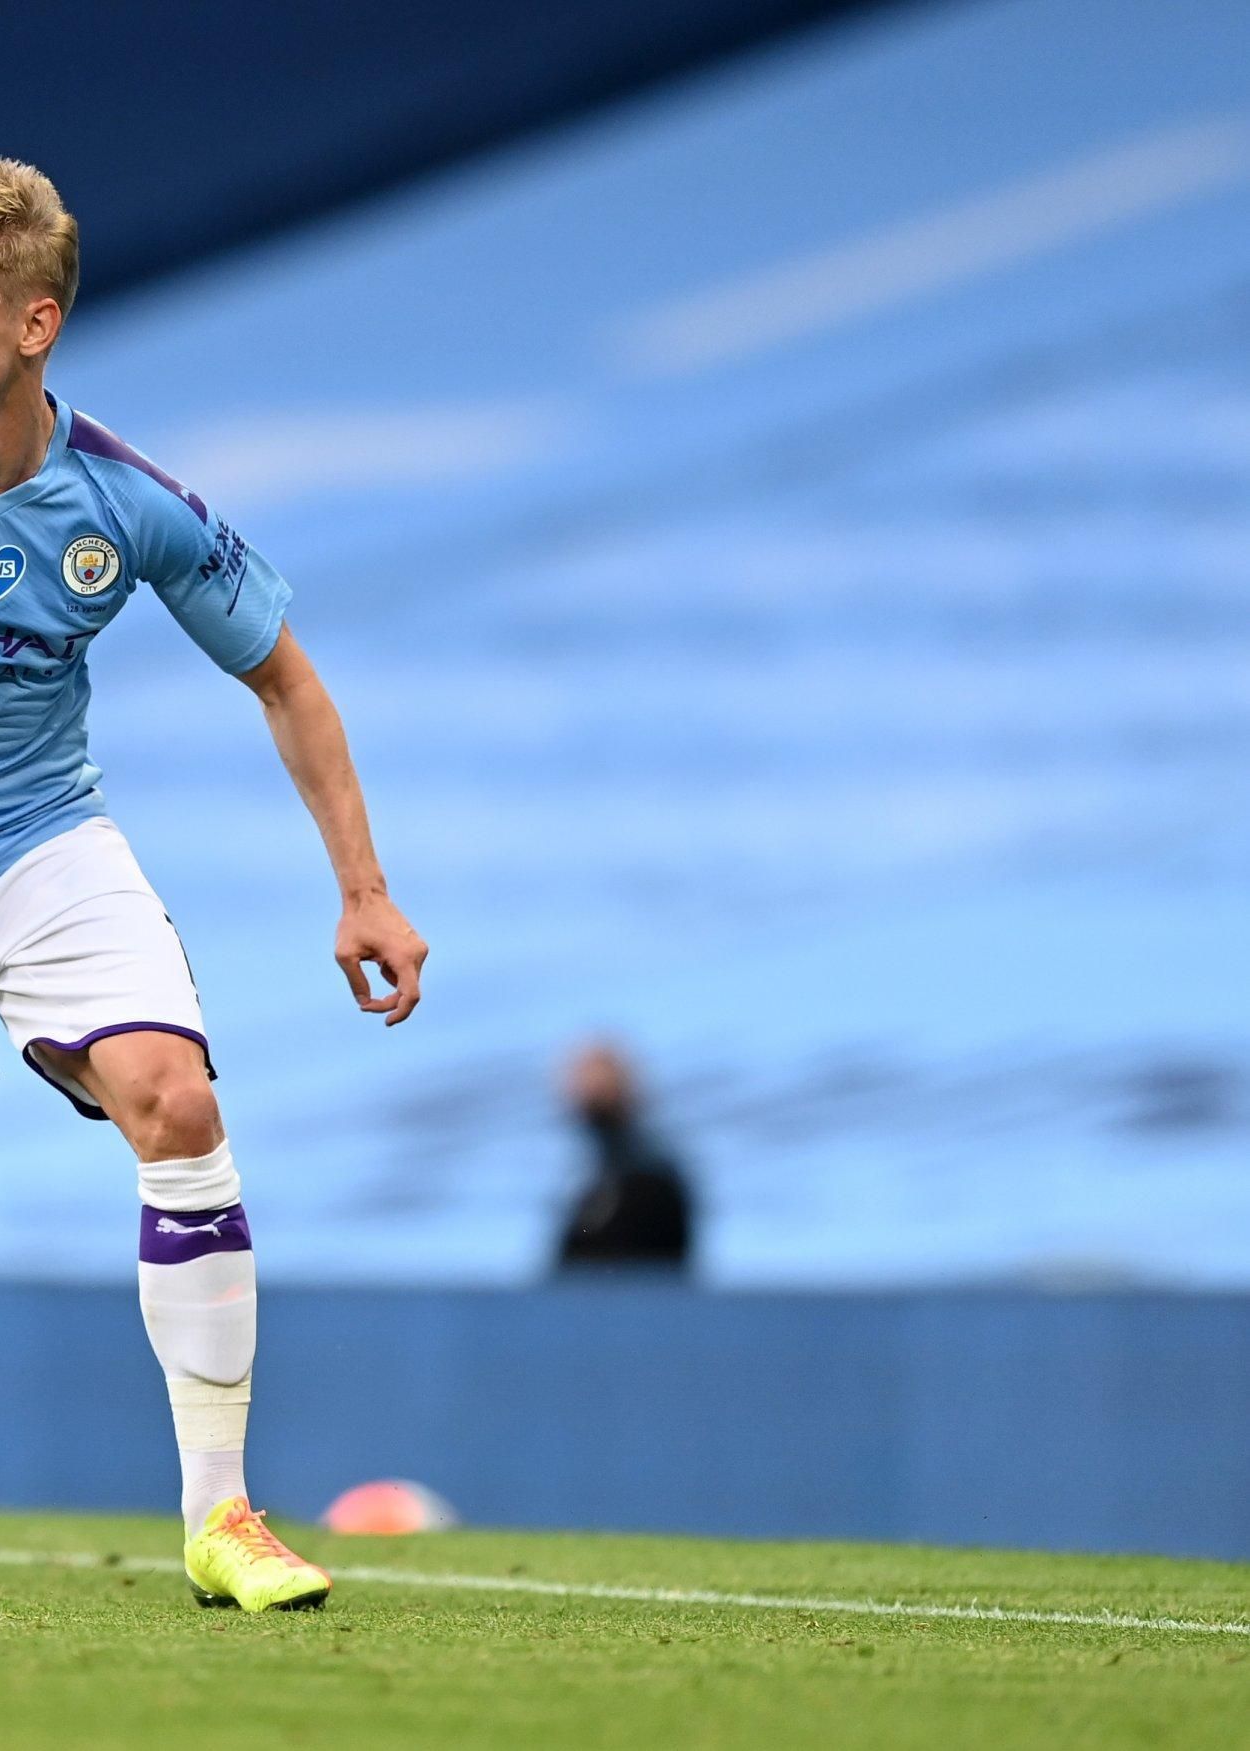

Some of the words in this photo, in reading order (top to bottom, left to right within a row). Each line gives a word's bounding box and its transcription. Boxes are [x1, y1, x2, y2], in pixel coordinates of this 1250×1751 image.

[67, 539, 116, 559] MANCHESTER
[198, 511, 230, 581] NEXE
[80, 585, 98, 593] CITY
